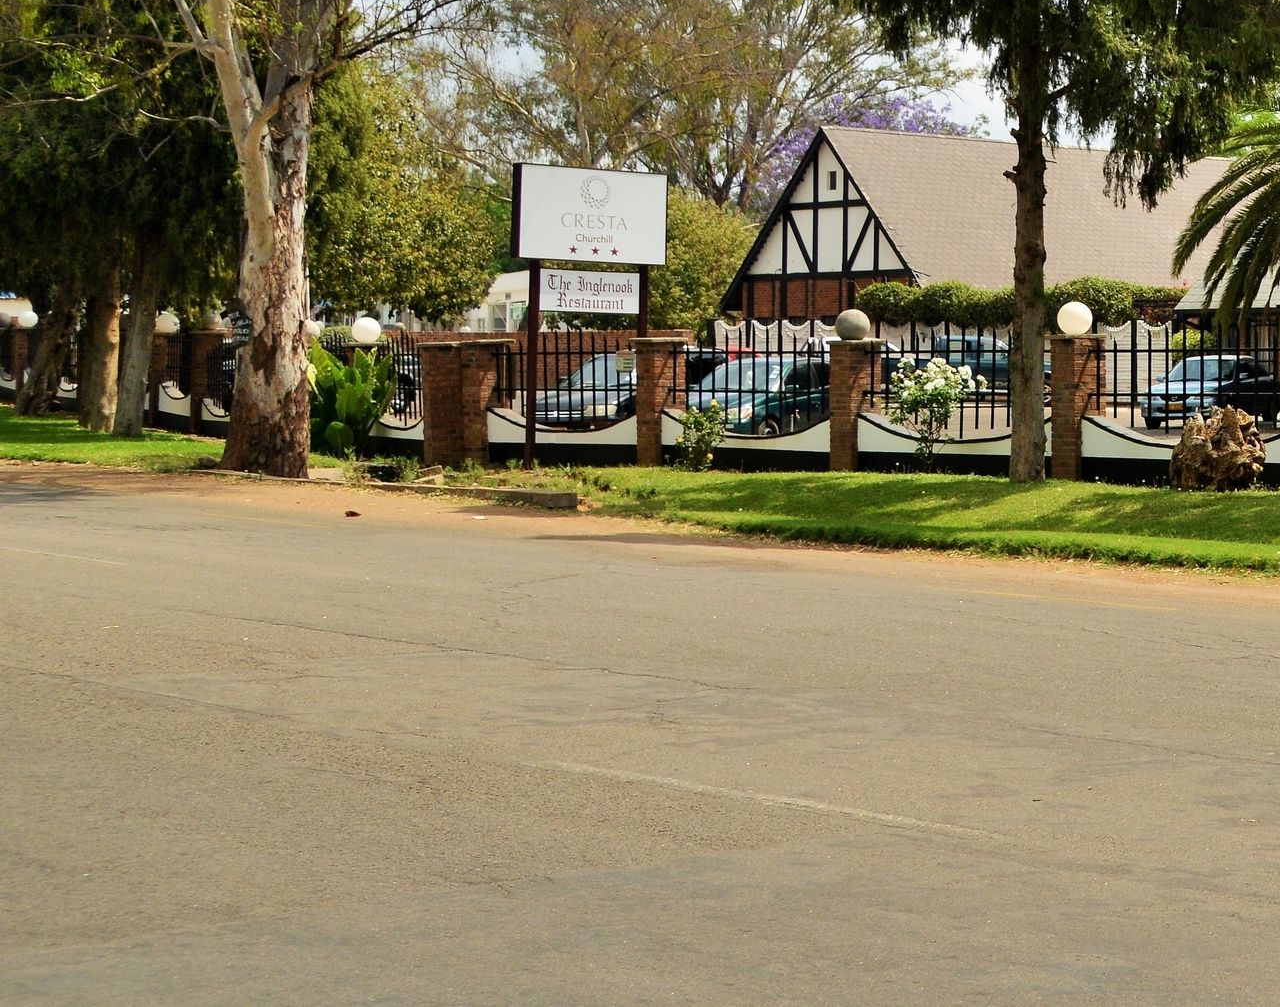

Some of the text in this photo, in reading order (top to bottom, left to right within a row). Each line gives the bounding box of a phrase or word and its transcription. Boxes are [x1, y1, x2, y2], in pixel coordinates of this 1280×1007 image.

[561, 212, 628, 231] CRESTA
[575, 233, 614, 244] Churchill
[547, 274, 633, 296] The Inglenook
[556, 292, 624, 310] Restaurant
